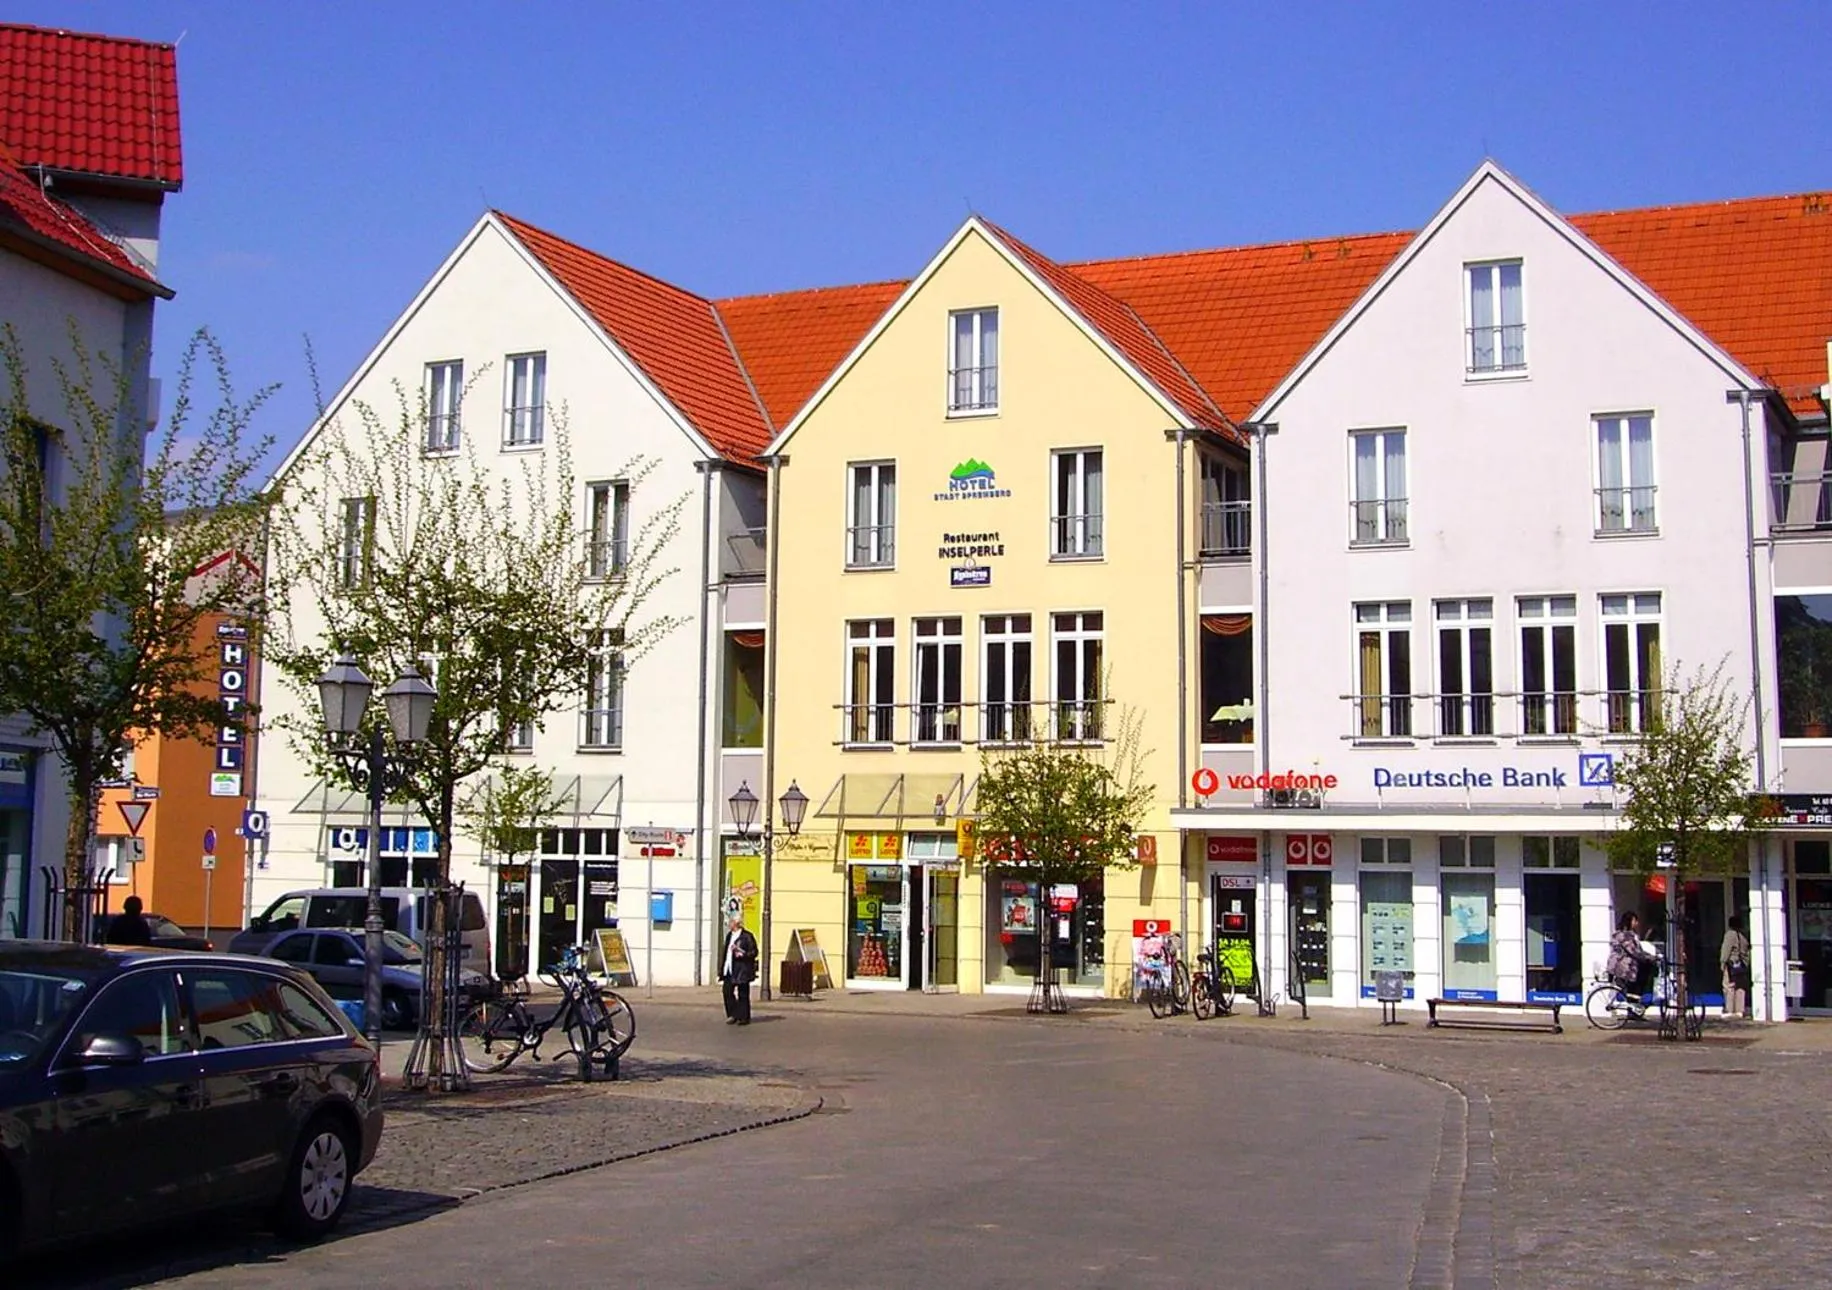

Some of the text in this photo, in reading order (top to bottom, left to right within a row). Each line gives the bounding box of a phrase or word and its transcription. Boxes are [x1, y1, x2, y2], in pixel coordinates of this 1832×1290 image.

[949, 479, 995, 491] HOTEL
[934, 492, 960, 501] STADT
[943, 532, 999, 543] Restaurant
[938, 545, 1004, 559] INSELPERLE
[221, 644, 242, 768] HOTEL
[1227, 770, 1337, 789] vodafone
[1373, 767, 1567, 788] Deutsche Bank
[1222, 877, 1241, 888] DSL
